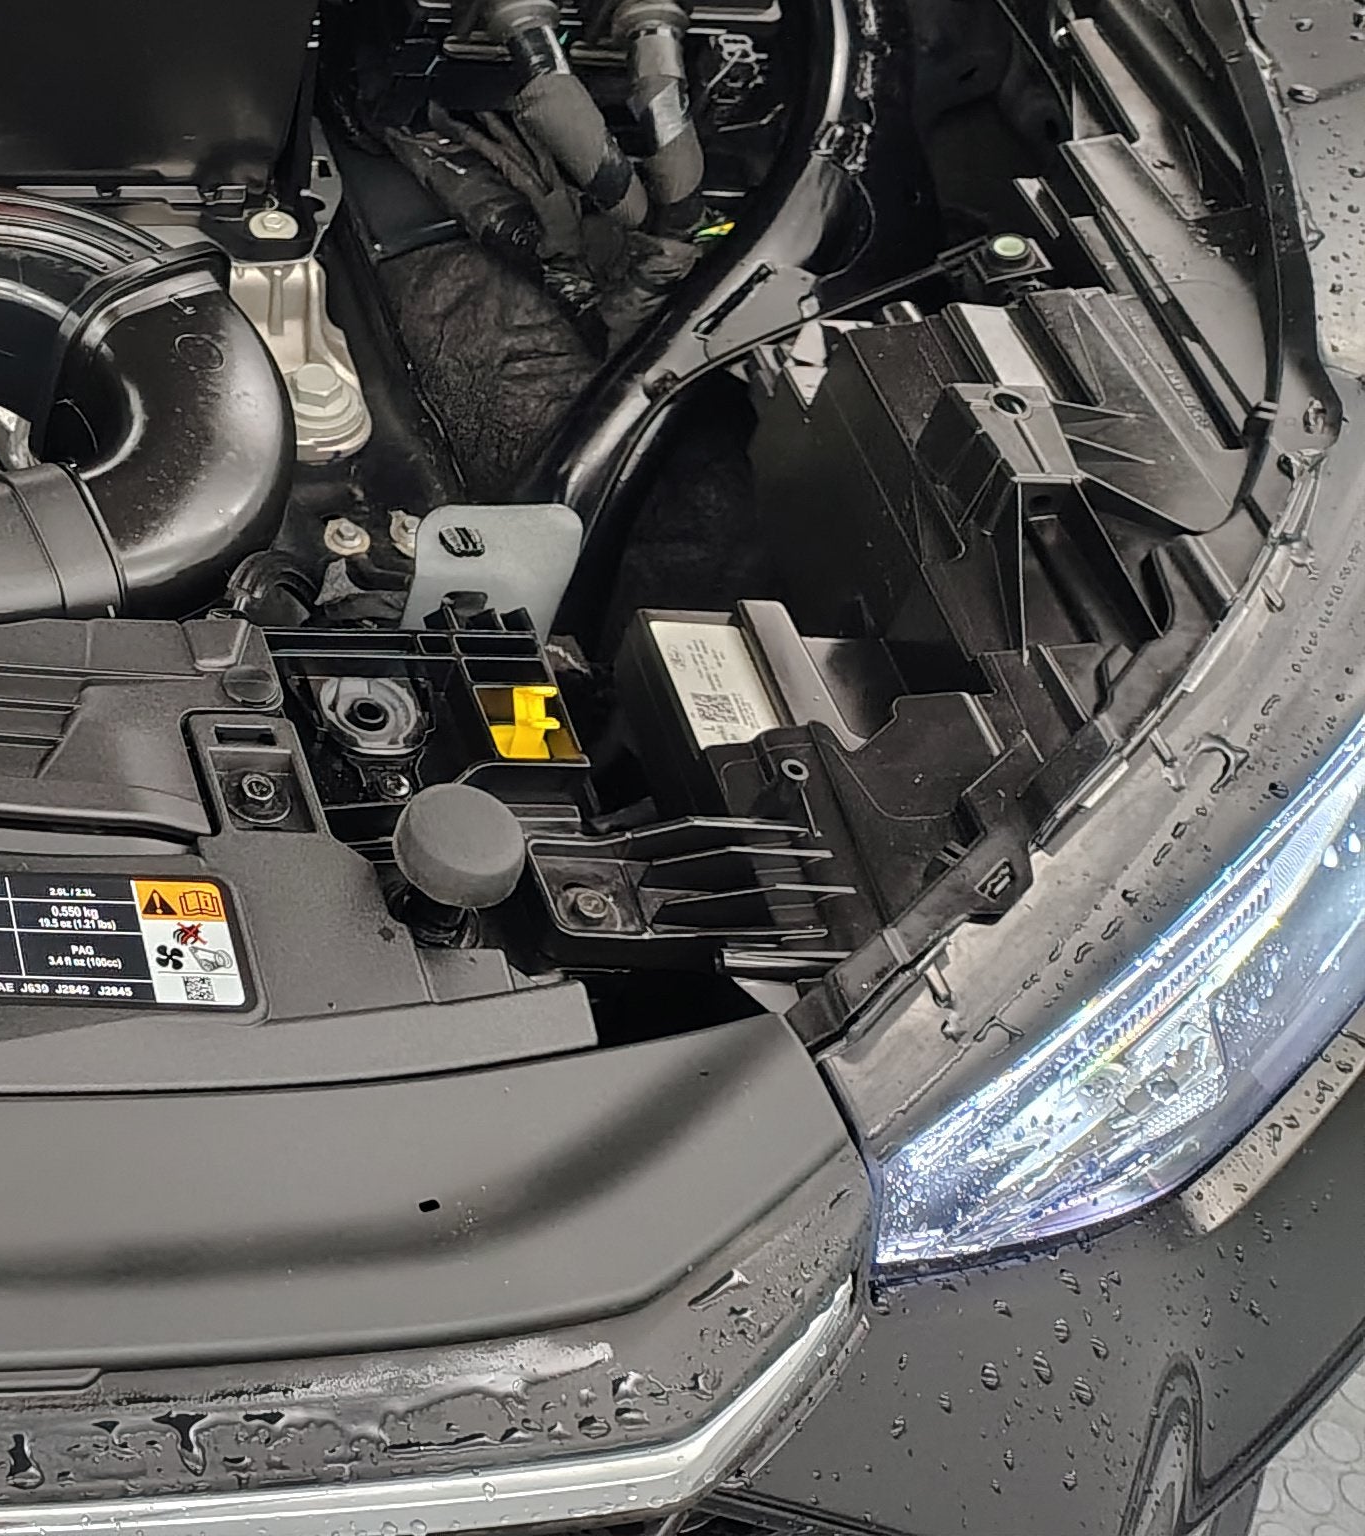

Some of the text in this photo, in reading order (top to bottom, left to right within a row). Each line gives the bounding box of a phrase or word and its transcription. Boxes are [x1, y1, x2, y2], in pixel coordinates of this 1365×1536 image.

[51, 905, 99, 920] 0.550 kg
[60, 919, 72, 928] oz
[97, 919, 116, 931] lbs)
[71, 944, 94, 955] PAG
[48, 956, 63, 966] 3.4
[64, 957, 72, 966] fl
[73, 959, 86, 967] oz
[20, 982, 49, 994] J639
